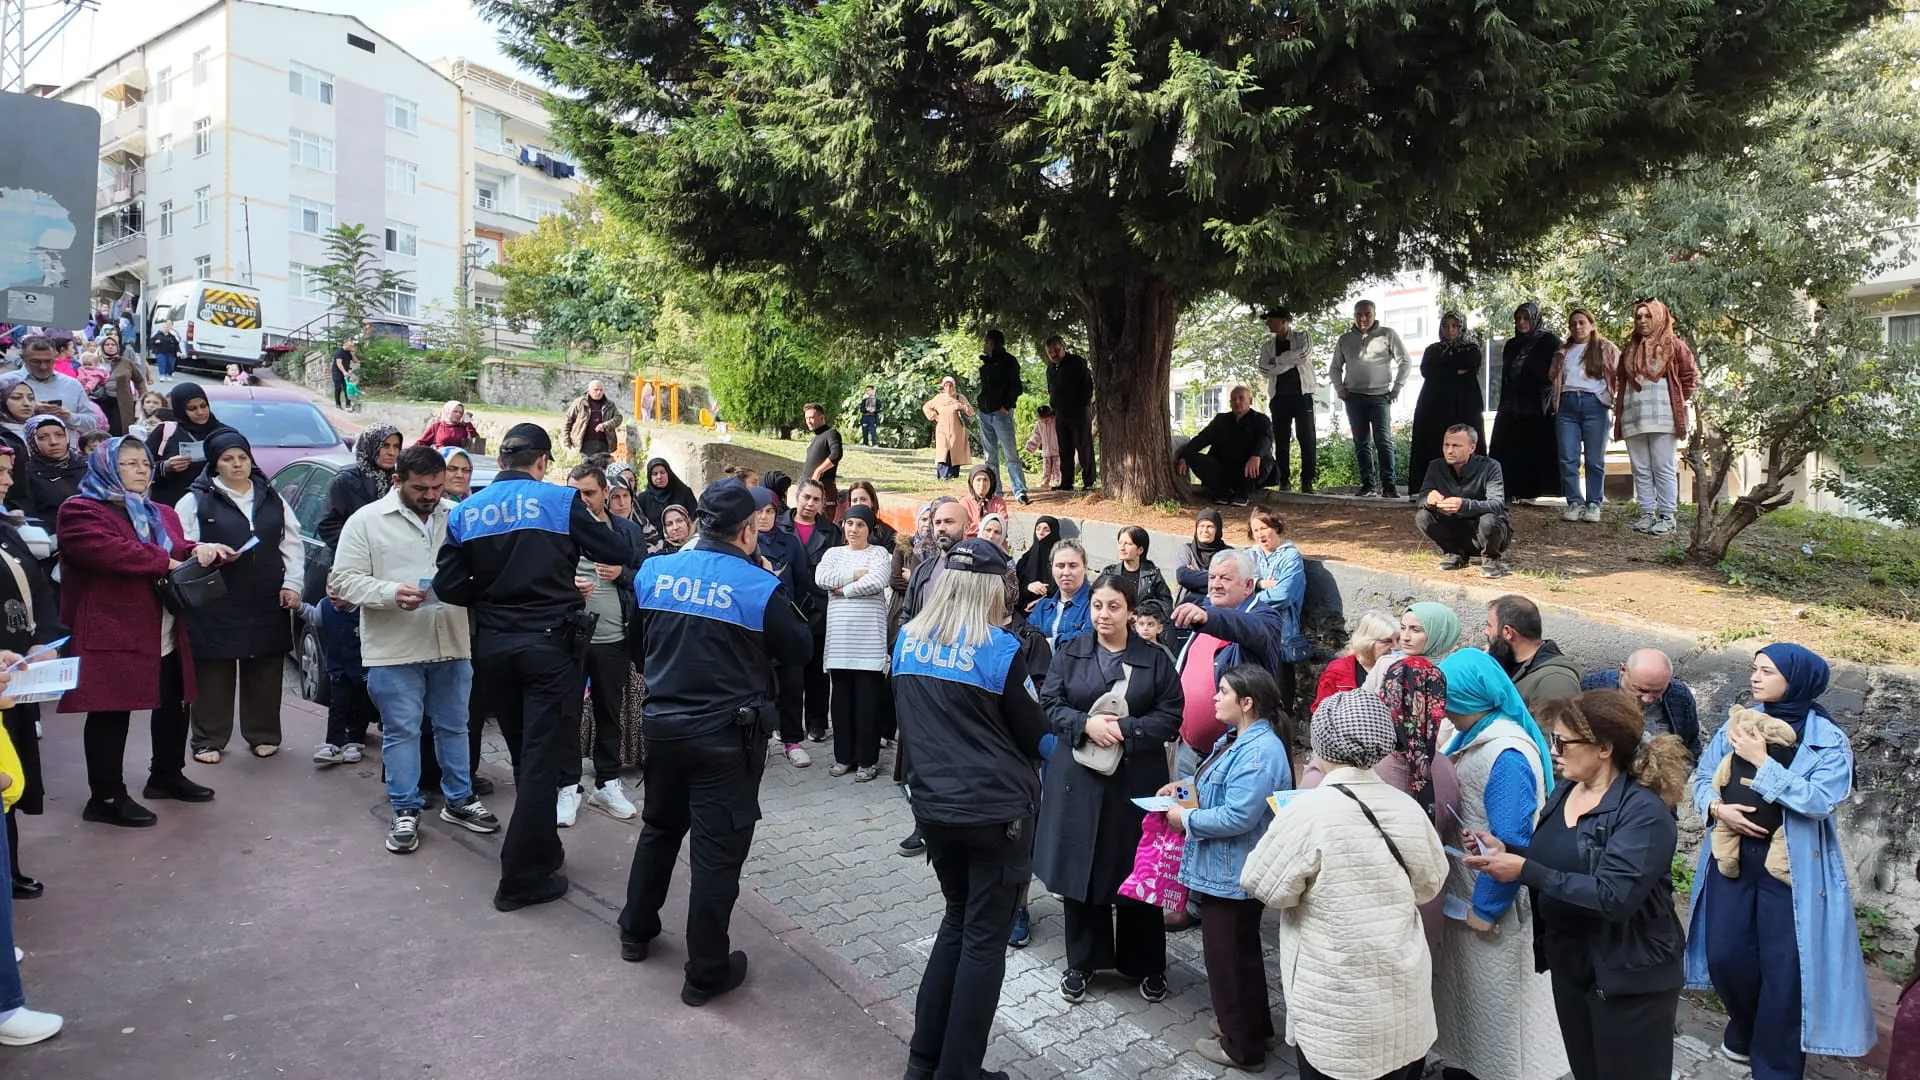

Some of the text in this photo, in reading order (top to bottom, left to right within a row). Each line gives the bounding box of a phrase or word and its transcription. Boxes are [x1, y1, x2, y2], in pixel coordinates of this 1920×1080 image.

[204, 302, 229, 313] OKUL
[1163, 888, 1182, 901] SIFIR
[1161, 899, 1178, 911] ATIK
